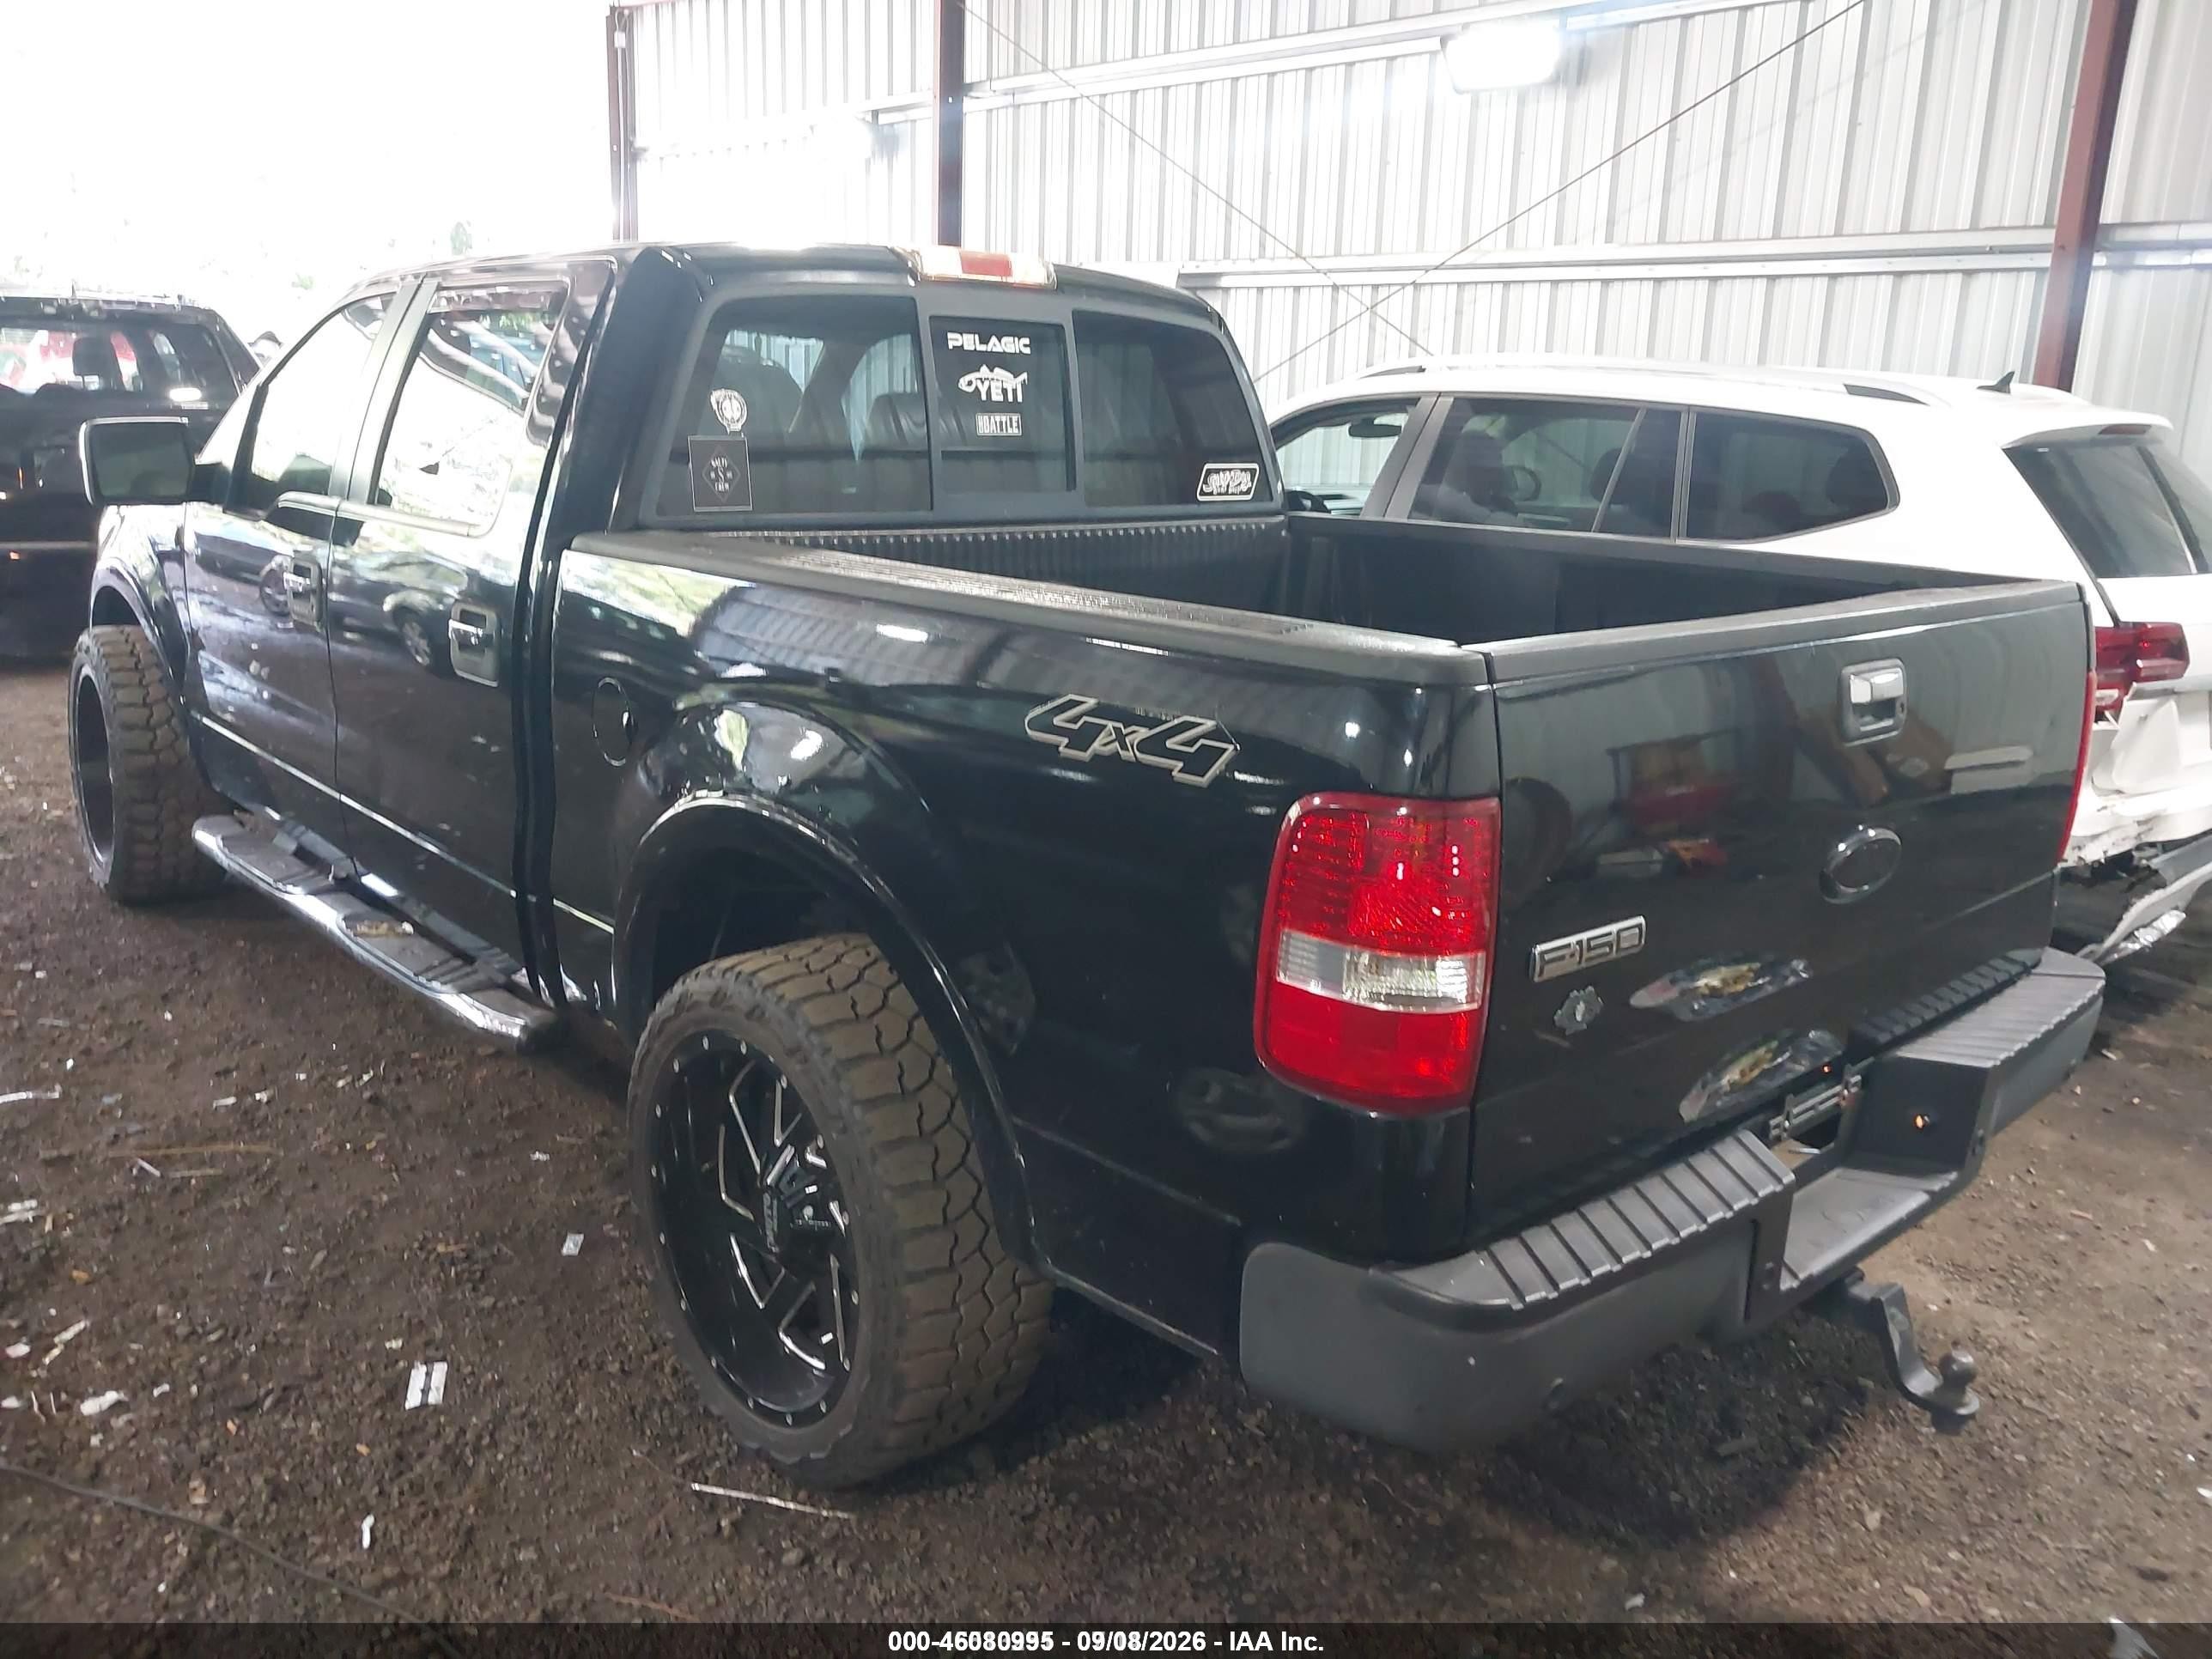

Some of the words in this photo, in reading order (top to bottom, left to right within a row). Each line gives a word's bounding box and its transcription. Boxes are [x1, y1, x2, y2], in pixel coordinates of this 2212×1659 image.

[947, 331, 1030, 355] PELAGIC
[976, 379, 1023, 403] YETI
[1024, 693, 1237, 787] 4x4
